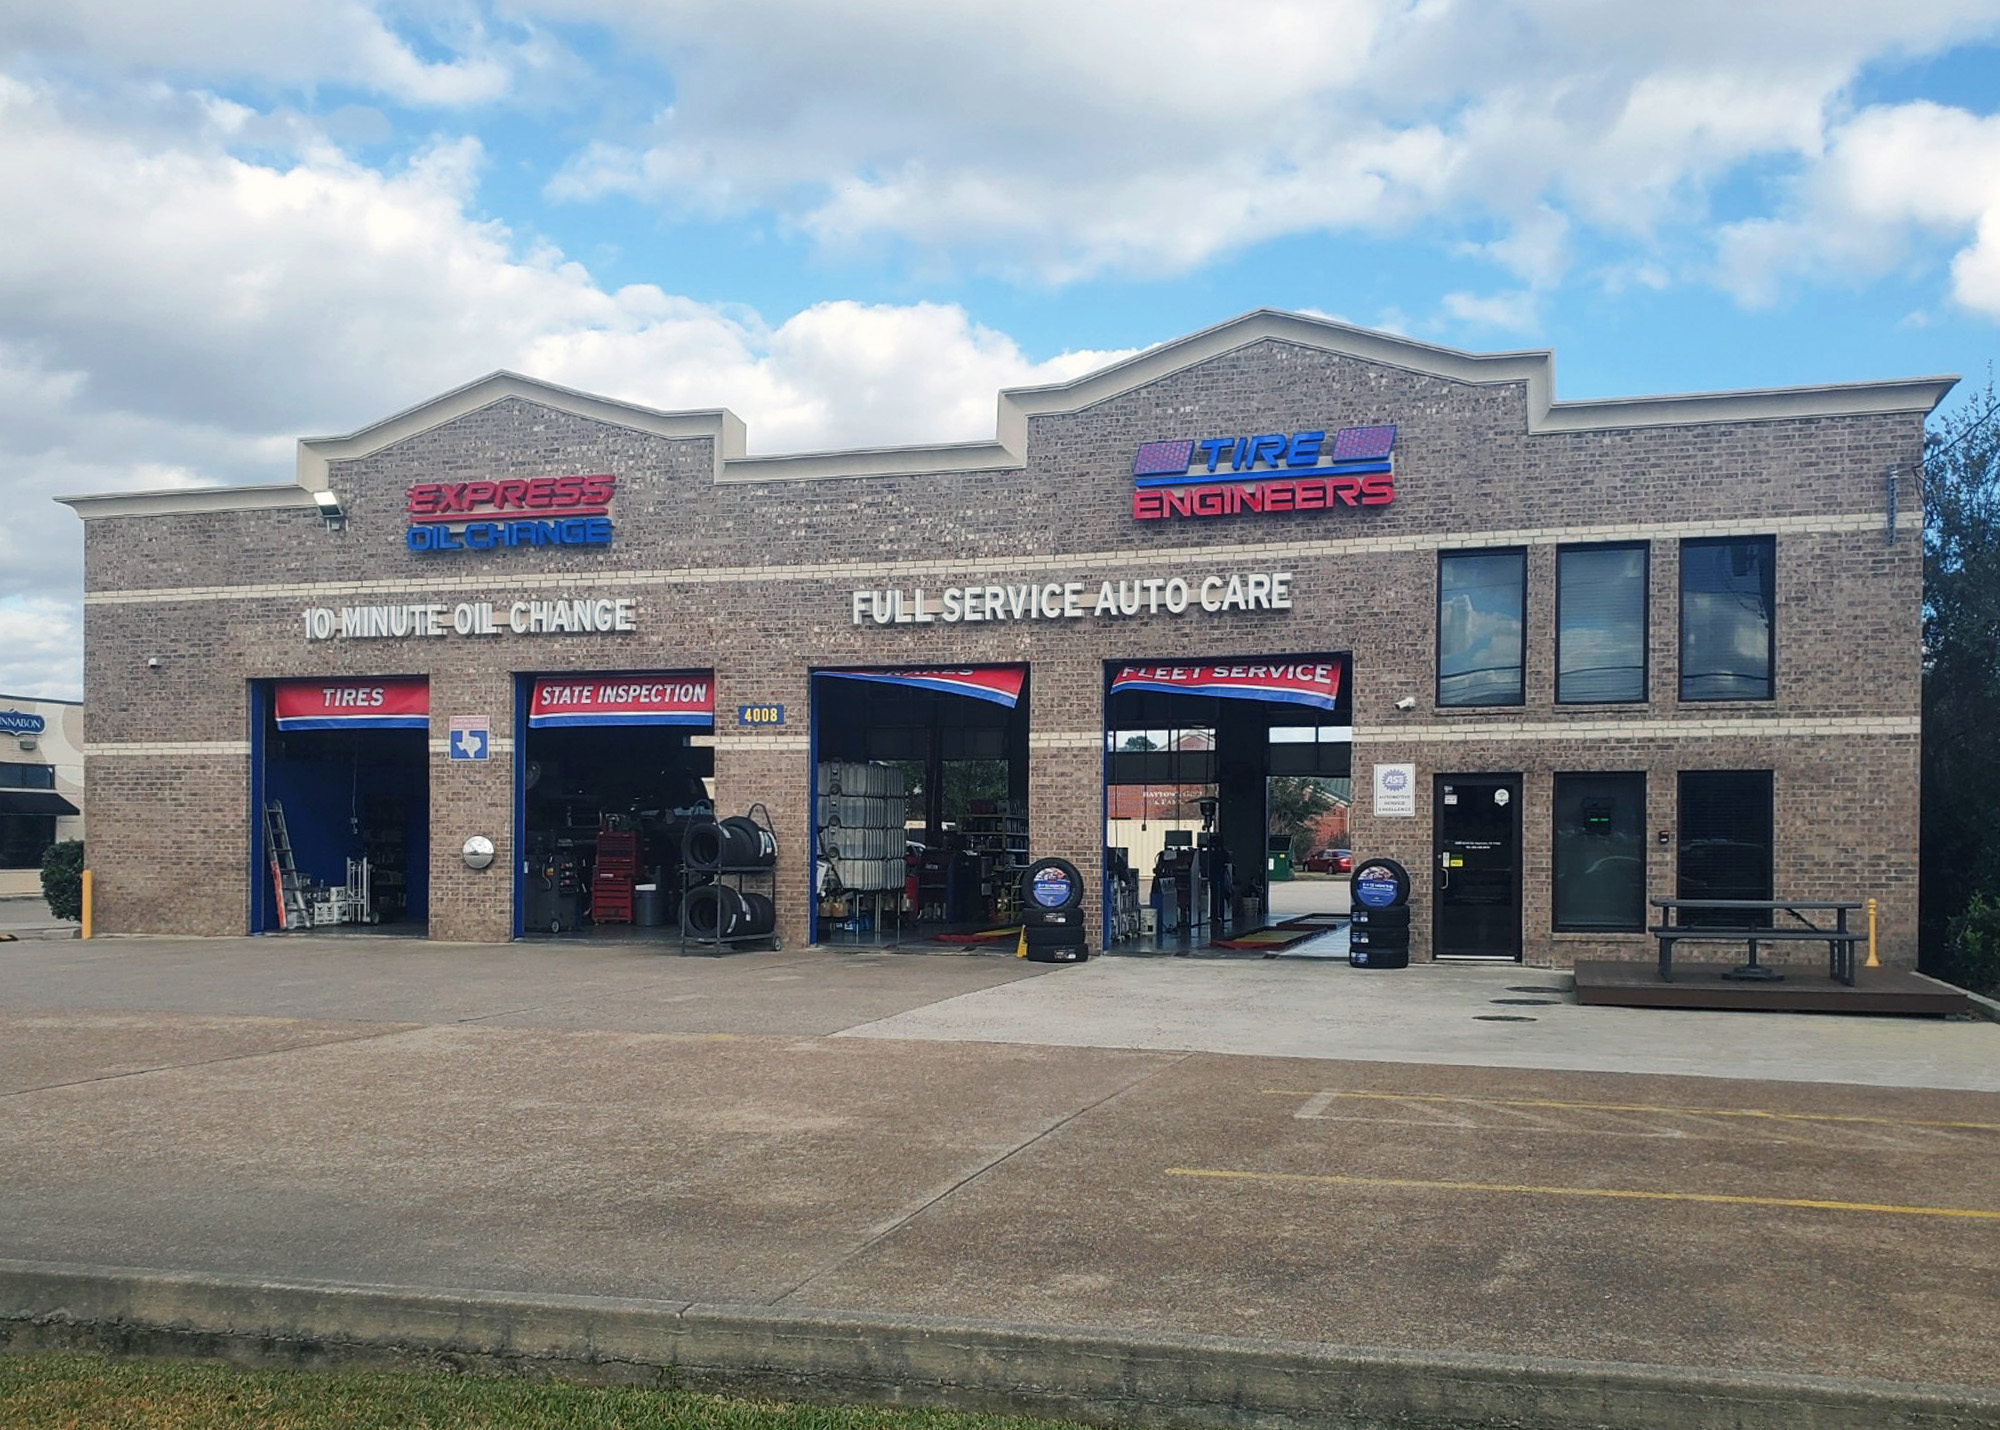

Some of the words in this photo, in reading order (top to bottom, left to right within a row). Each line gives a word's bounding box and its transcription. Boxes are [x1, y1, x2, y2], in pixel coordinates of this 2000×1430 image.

[1200, 431, 1326, 472] TIRE
[405, 475, 616, 513] EXPRESS
[1133, 474, 1396, 520] ENGINEERS
[406, 525, 463, 551] OIL
[464, 517, 613, 549] CHANGE
[852, 588, 935, 625] FULL
[941, 582, 1084, 622] SERVICE
[1094, 576, 1189, 616] AUTO
[1200, 571, 1293, 612] CARE
[302, 607, 336, 640] 10
[340, 603, 448, 638] MINUTE
[453, 601, 501, 635] OIL
[509, 598, 637, 634] CHANGE
[1121, 665, 1207, 681] FLEET
[1211, 663, 1333, 685] SERVICE
[322, 687, 384, 707] TIRES
[540, 685, 594, 707] STATE
[597, 683, 708, 705] INSPECTION
[744, 707, 778, 723] 4008
